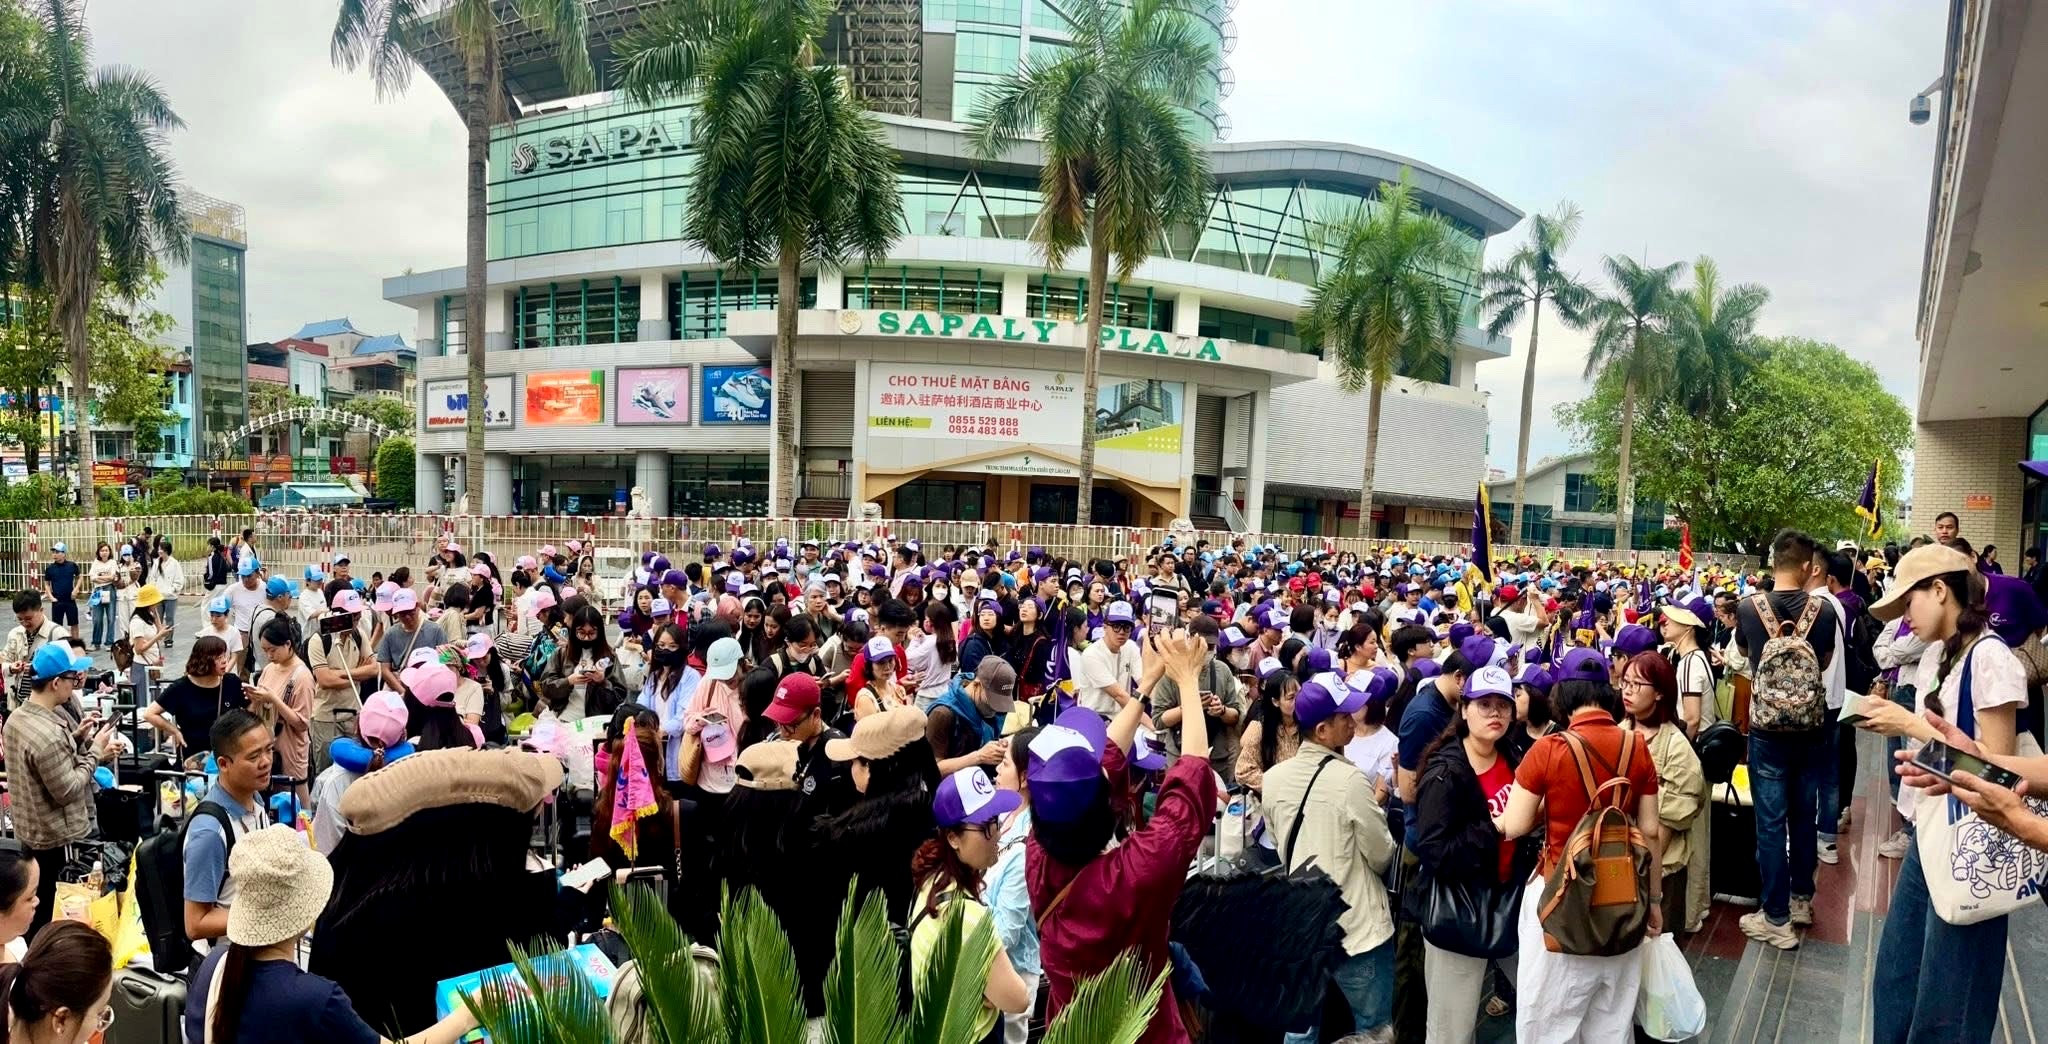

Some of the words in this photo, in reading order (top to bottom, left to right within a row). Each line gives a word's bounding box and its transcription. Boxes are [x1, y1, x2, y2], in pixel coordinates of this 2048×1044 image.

[878, 311, 1058, 343] SAPALY
[1100, 327, 1221, 361] PLAZA
[888, 375, 918, 387] CHO
[921, 375, 957, 388] THUÊ
[961, 376, 990, 391] MẶT
[881, 392, 1043, 412] 邀请入驻萨帕利酒店商业中心
[876, 416, 896, 426] LIÊN
[897, 416, 912, 427] HỆ:
[949, 415, 976, 425] 0855
[978, 417, 997, 426] 529
[999, 418, 1019, 427] 888
[948, 425, 975, 434] 0934
[977, 426, 997, 435] 483
[999, 427, 1019, 436] 465
